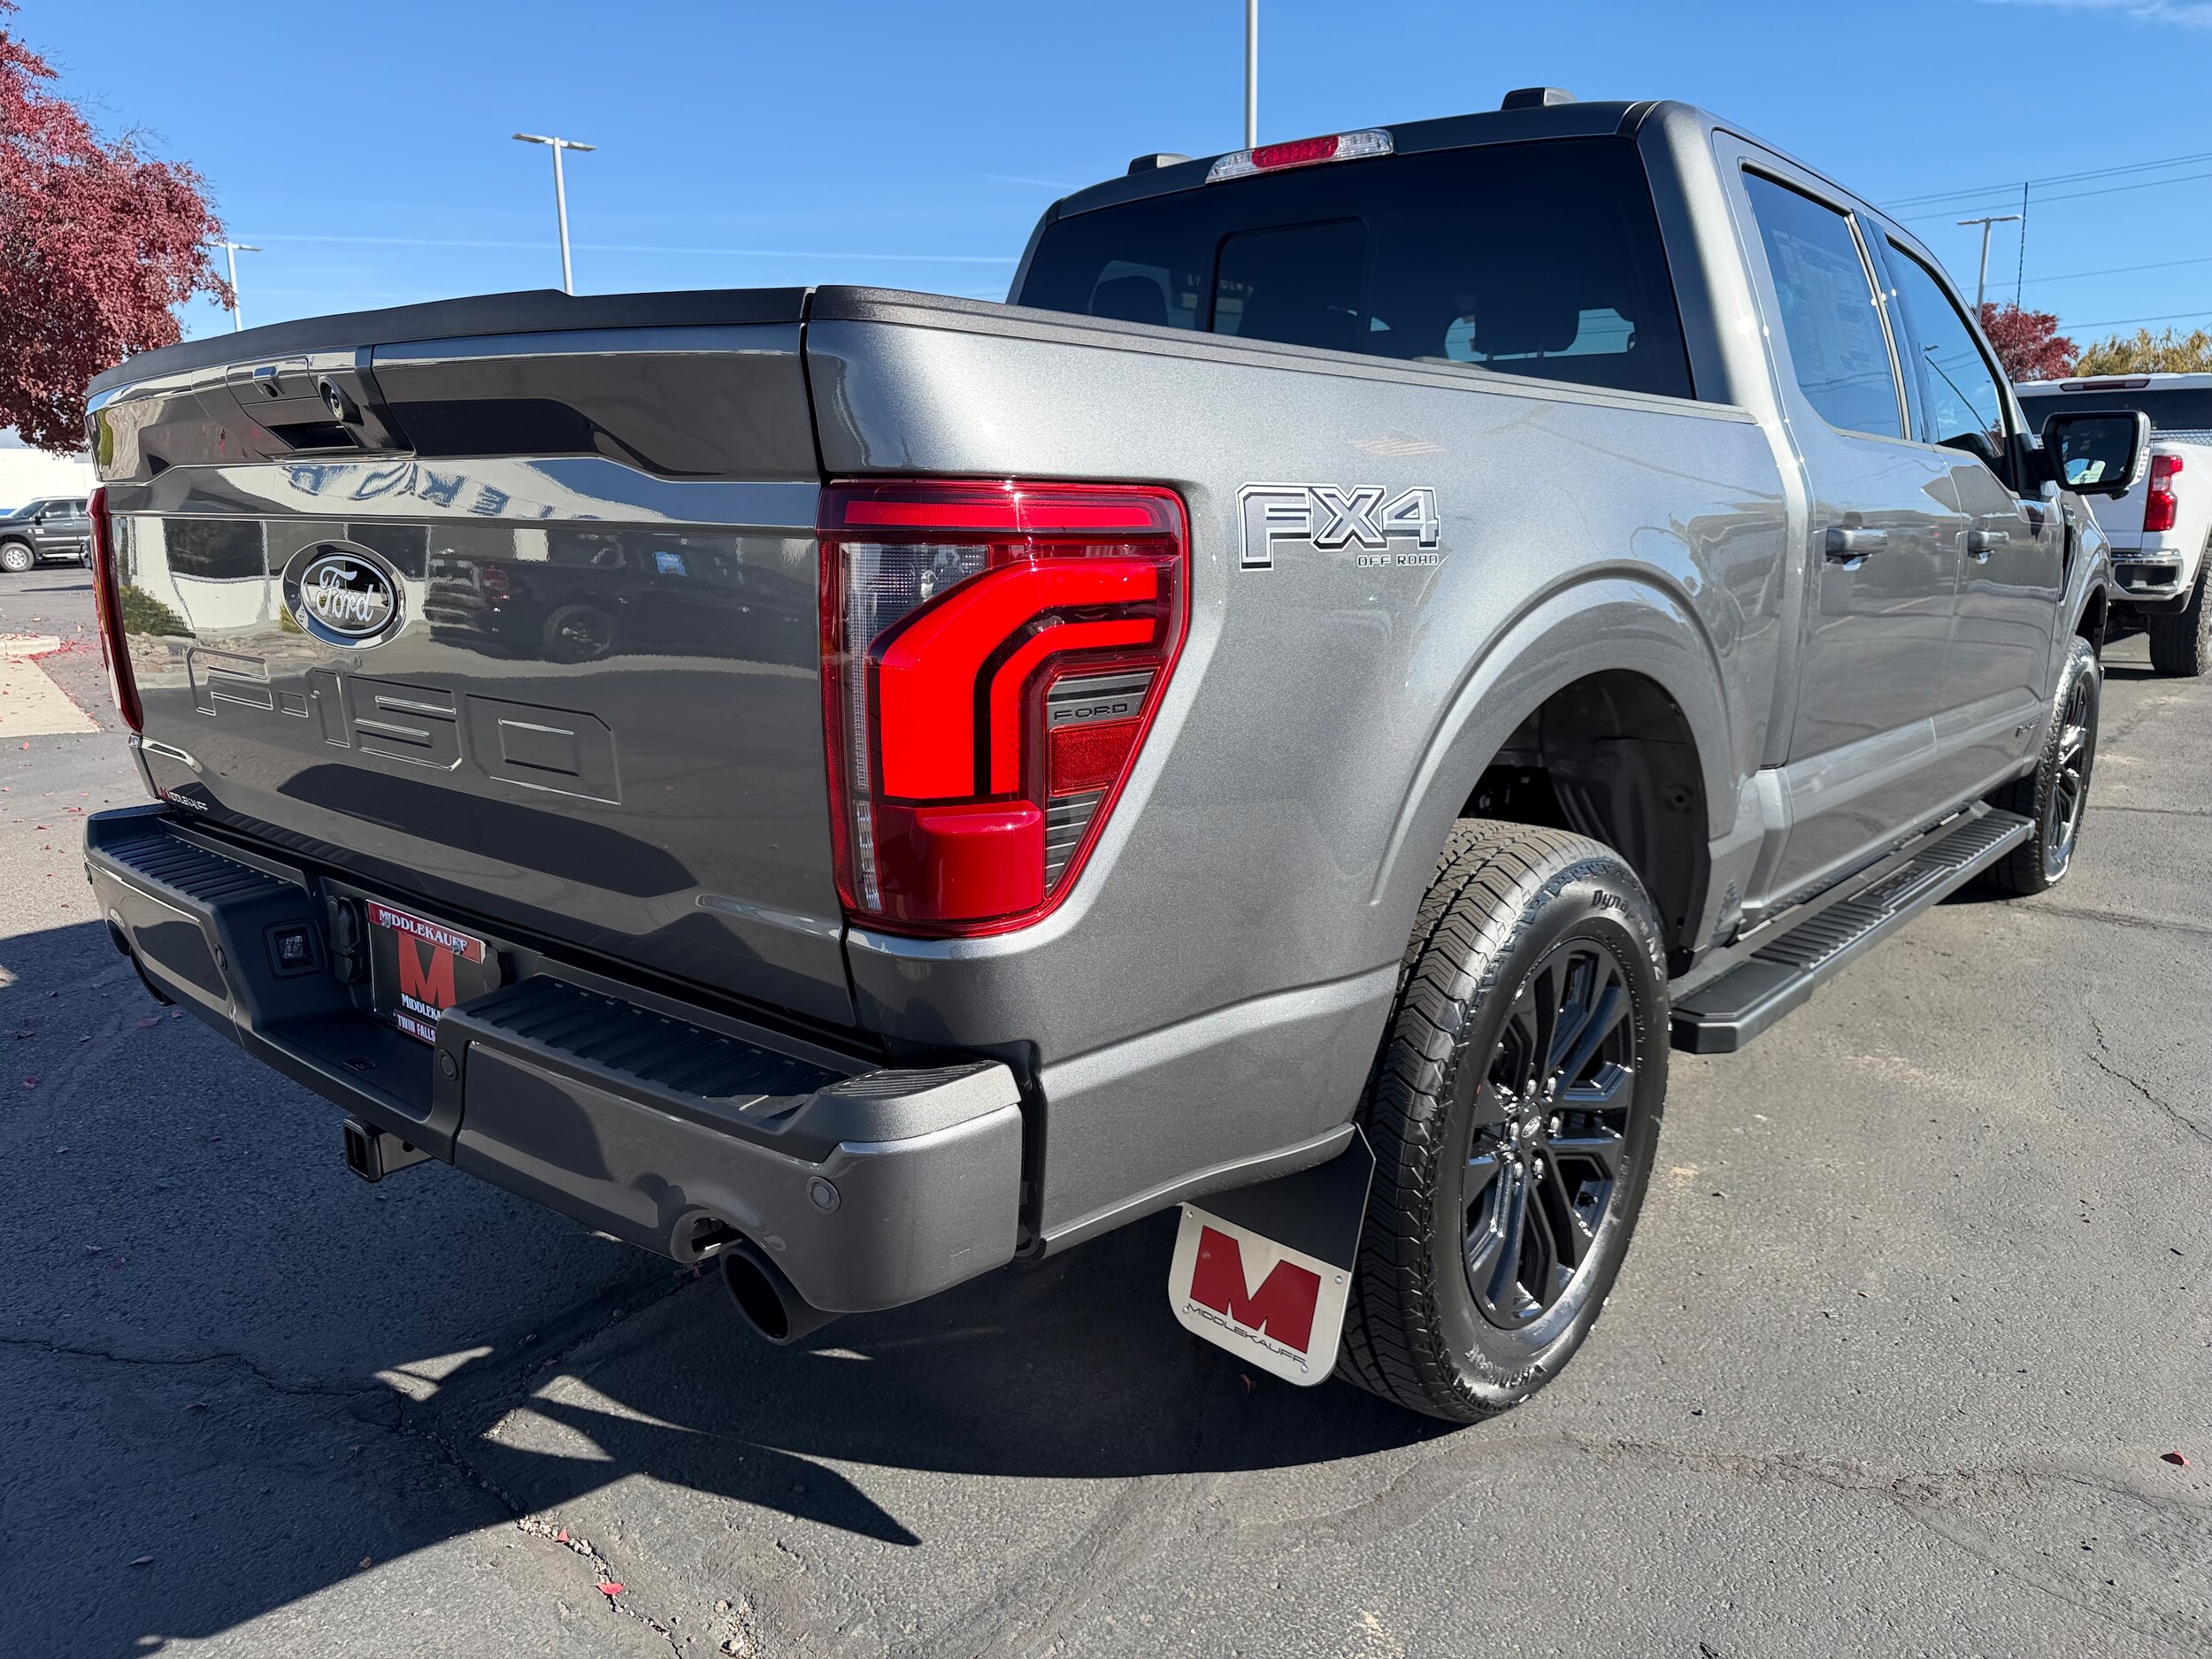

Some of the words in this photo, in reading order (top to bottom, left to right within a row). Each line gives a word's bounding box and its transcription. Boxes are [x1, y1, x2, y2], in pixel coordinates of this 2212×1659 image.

[1236, 481, 1440, 572] FX4
[1357, 554, 1391, 567] OFF
[1396, 554, 1439, 566] ROAD
[316, 565, 374, 623] Ford
[186, 647, 621, 805] F-150
[1054, 703, 1128, 721] FORD
[396, 1014, 416, 1033] TWIN
[417, 1023, 436, 1042] FALLS
[401, 993, 443, 1021] MIDDLEKA
[1190, 1225, 1321, 1355] M
[1187, 1302, 1307, 1365] MIDDLEKAUFF
